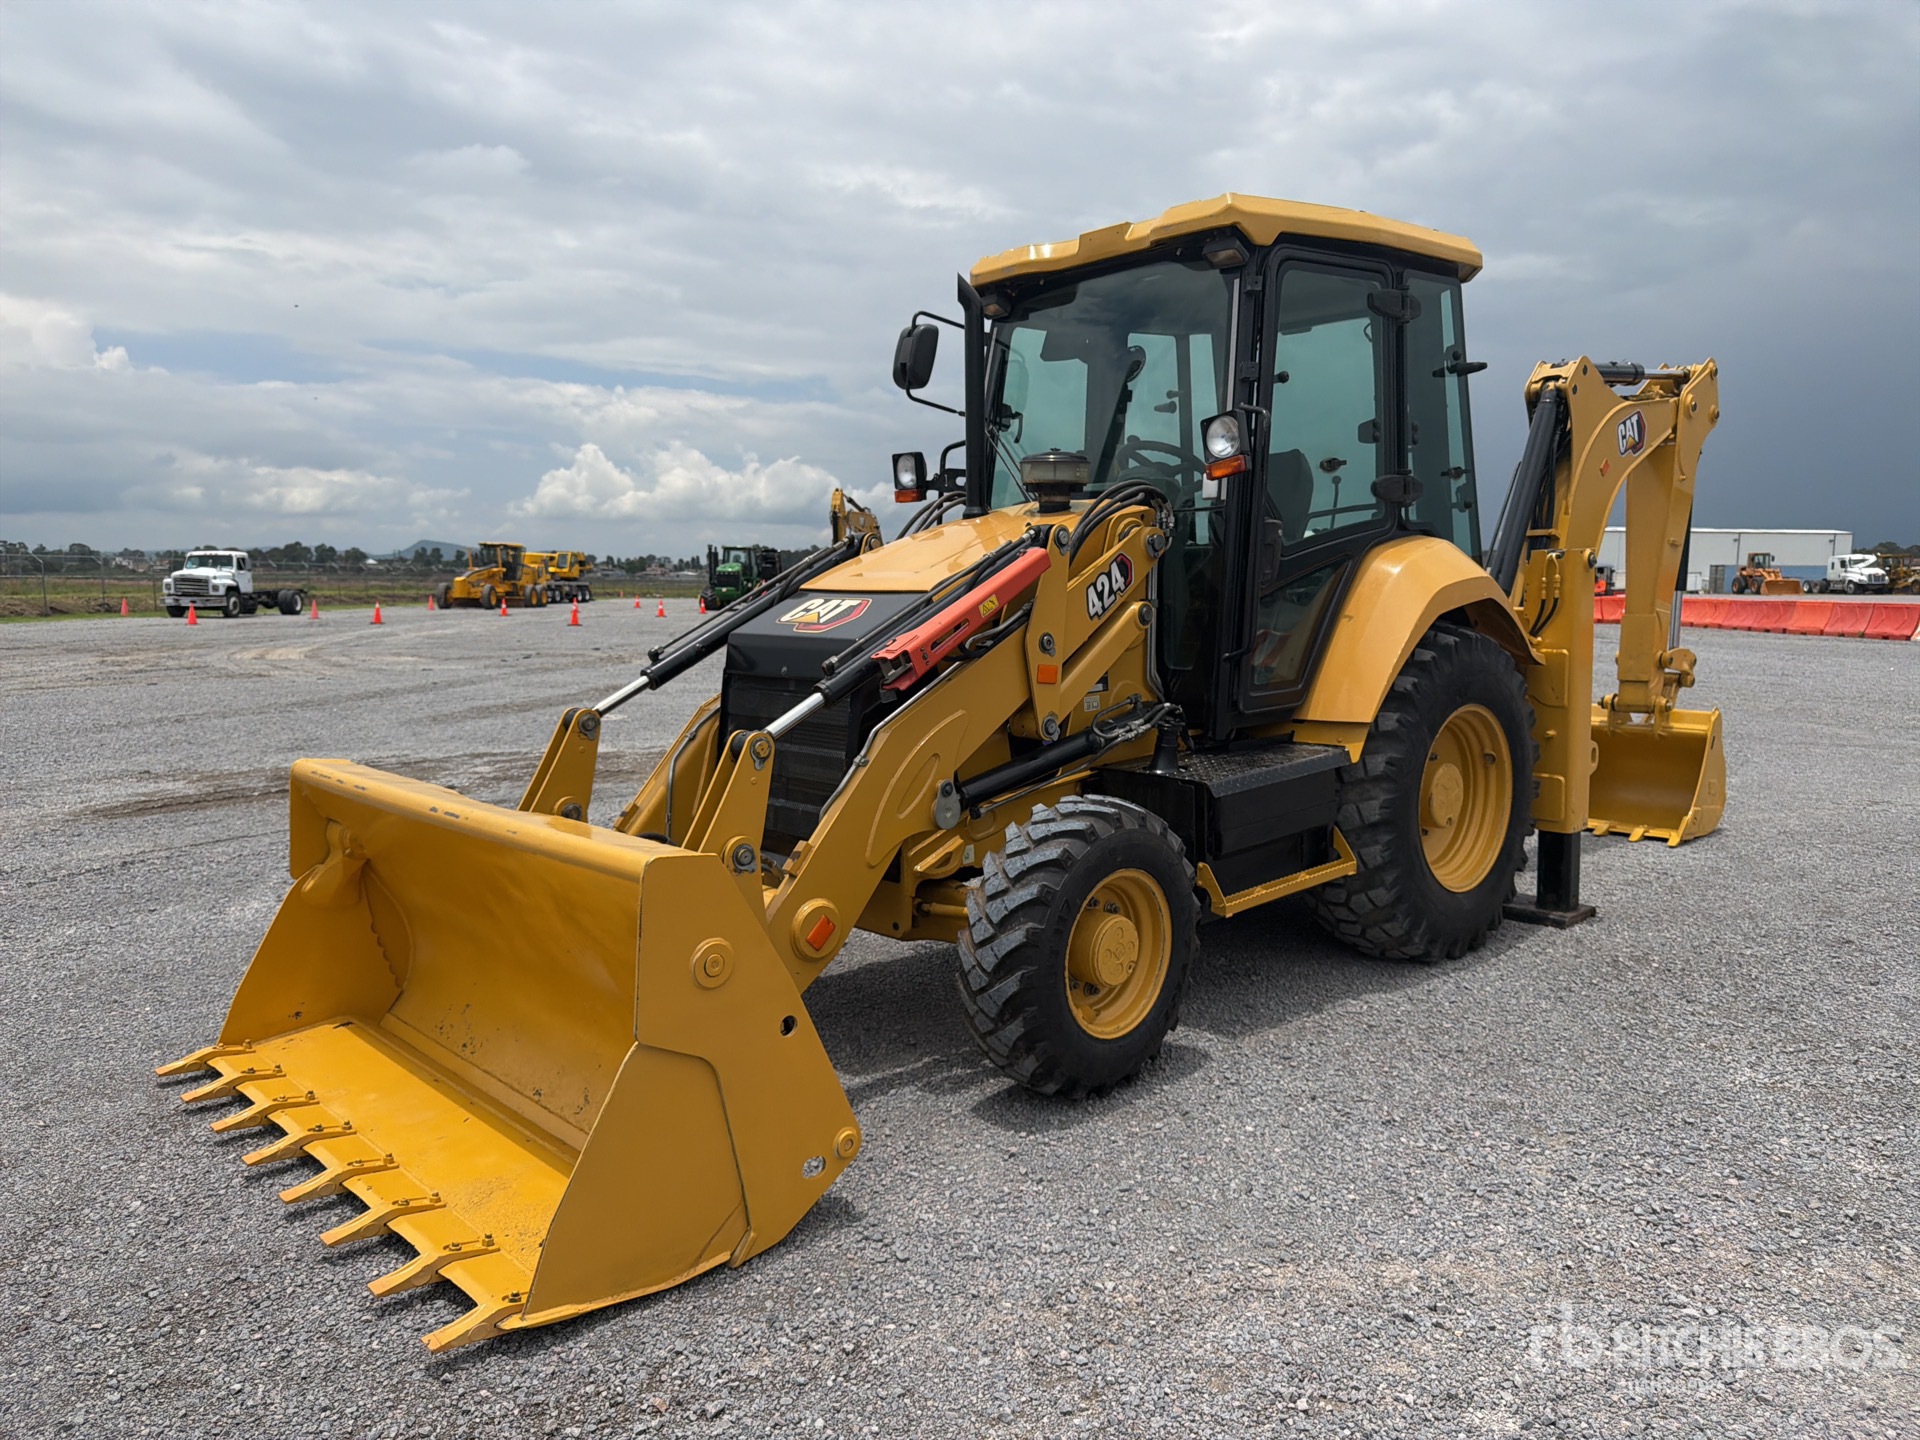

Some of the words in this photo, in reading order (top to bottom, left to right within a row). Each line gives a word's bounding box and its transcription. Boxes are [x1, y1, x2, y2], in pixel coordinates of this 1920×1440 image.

[1618, 413, 1640, 454] CAT
[1087, 560, 1126, 617] 424
[780, 598, 863, 624] CAT
